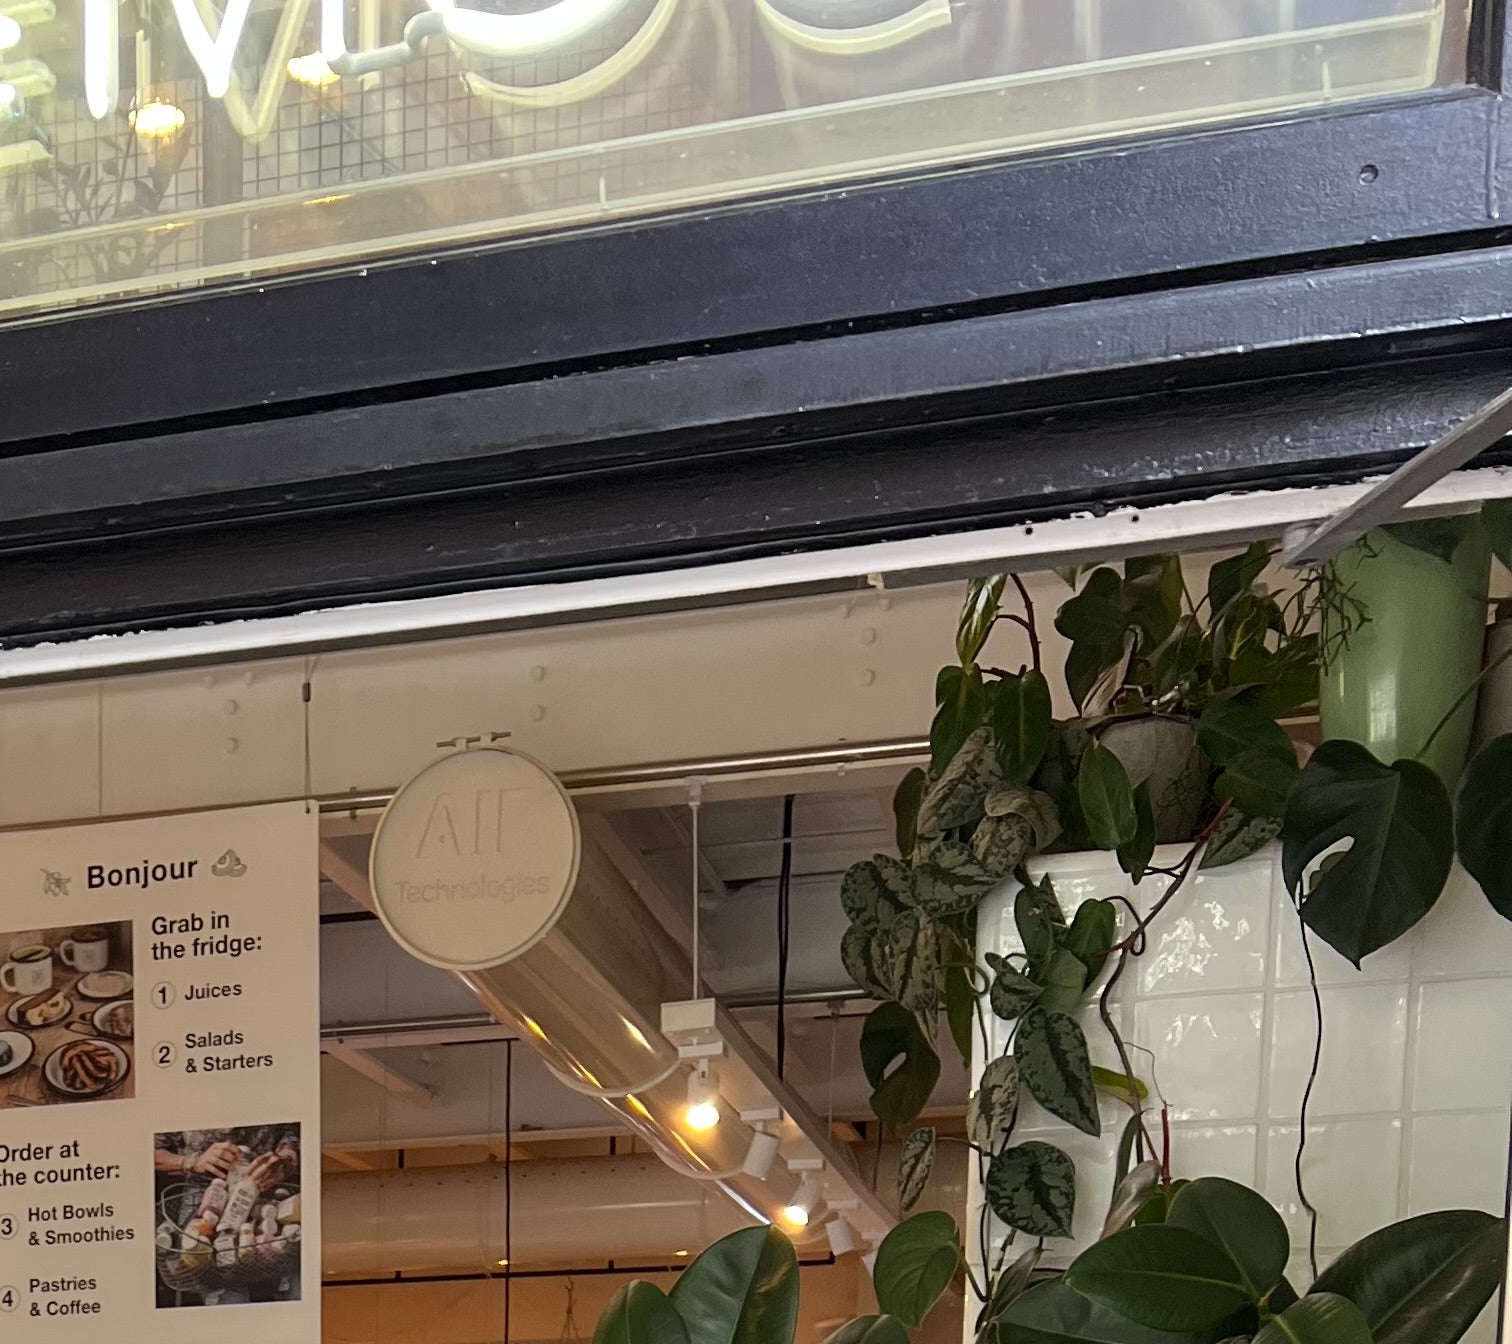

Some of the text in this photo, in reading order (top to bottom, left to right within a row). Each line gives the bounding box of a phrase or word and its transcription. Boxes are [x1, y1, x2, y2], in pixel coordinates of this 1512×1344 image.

[87, 860, 198, 889] Bonjour
[395, 873, 551, 904] Technologies
[151, 910, 230, 936] Grab in
[151, 934, 262, 961] the fridge:
[184, 983, 243, 1001] Juices
[184, 1029, 244, 1049] Salads
[158, 1045, 274, 1073] 2 & Starters
[59, 1140, 80, 1158] at
[33, 1163, 120, 1184] counter:
[28, 1202, 114, 1222] Hot Bowls
[0, 1217, 135, 1246] 3 & Smoothies
[29, 1275, 97, 1293] Pastries
[1, 1289, 101, 1317] 4 & Coffee
